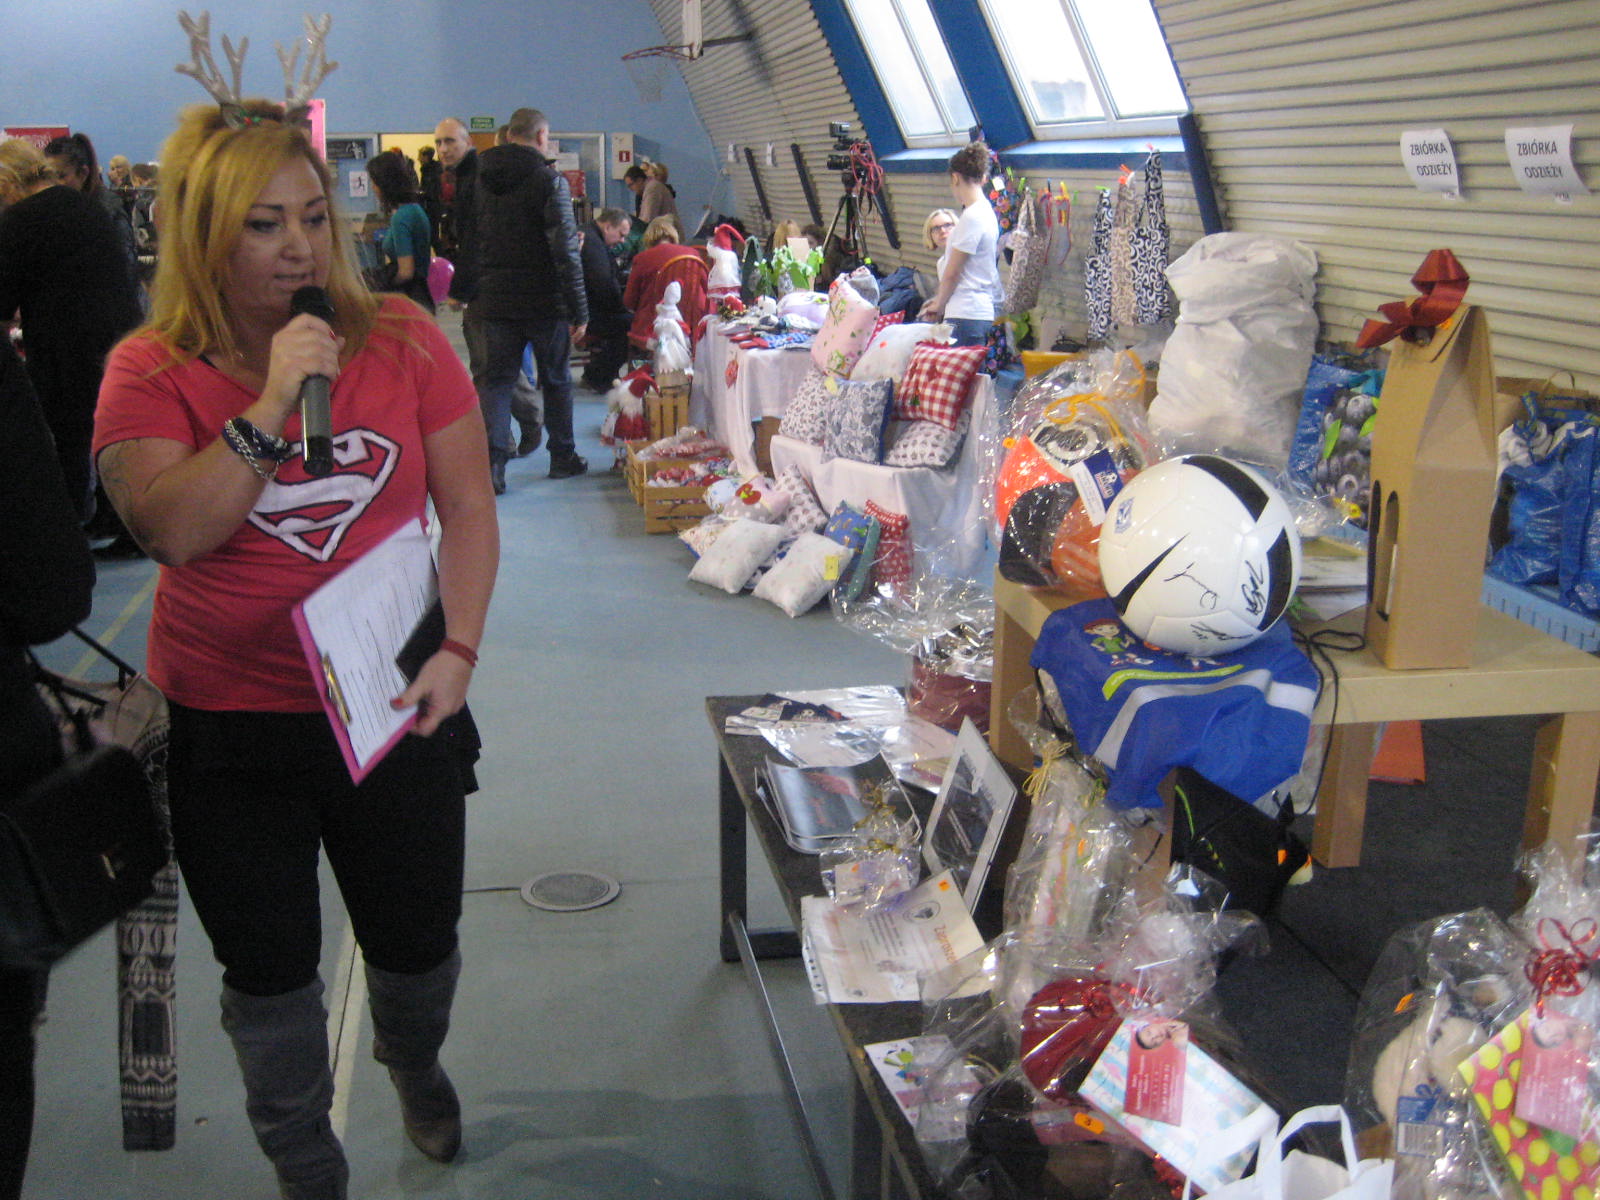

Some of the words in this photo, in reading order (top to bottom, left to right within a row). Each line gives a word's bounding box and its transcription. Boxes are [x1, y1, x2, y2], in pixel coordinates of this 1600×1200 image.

[1410, 140, 1448, 156] ZBIÓRKA
[1516, 138, 1558, 156] ZBIÓRKA
[1416, 161, 1452, 176] ODZIEŻY
[1524, 163, 1563, 178] ODZIEŻY
